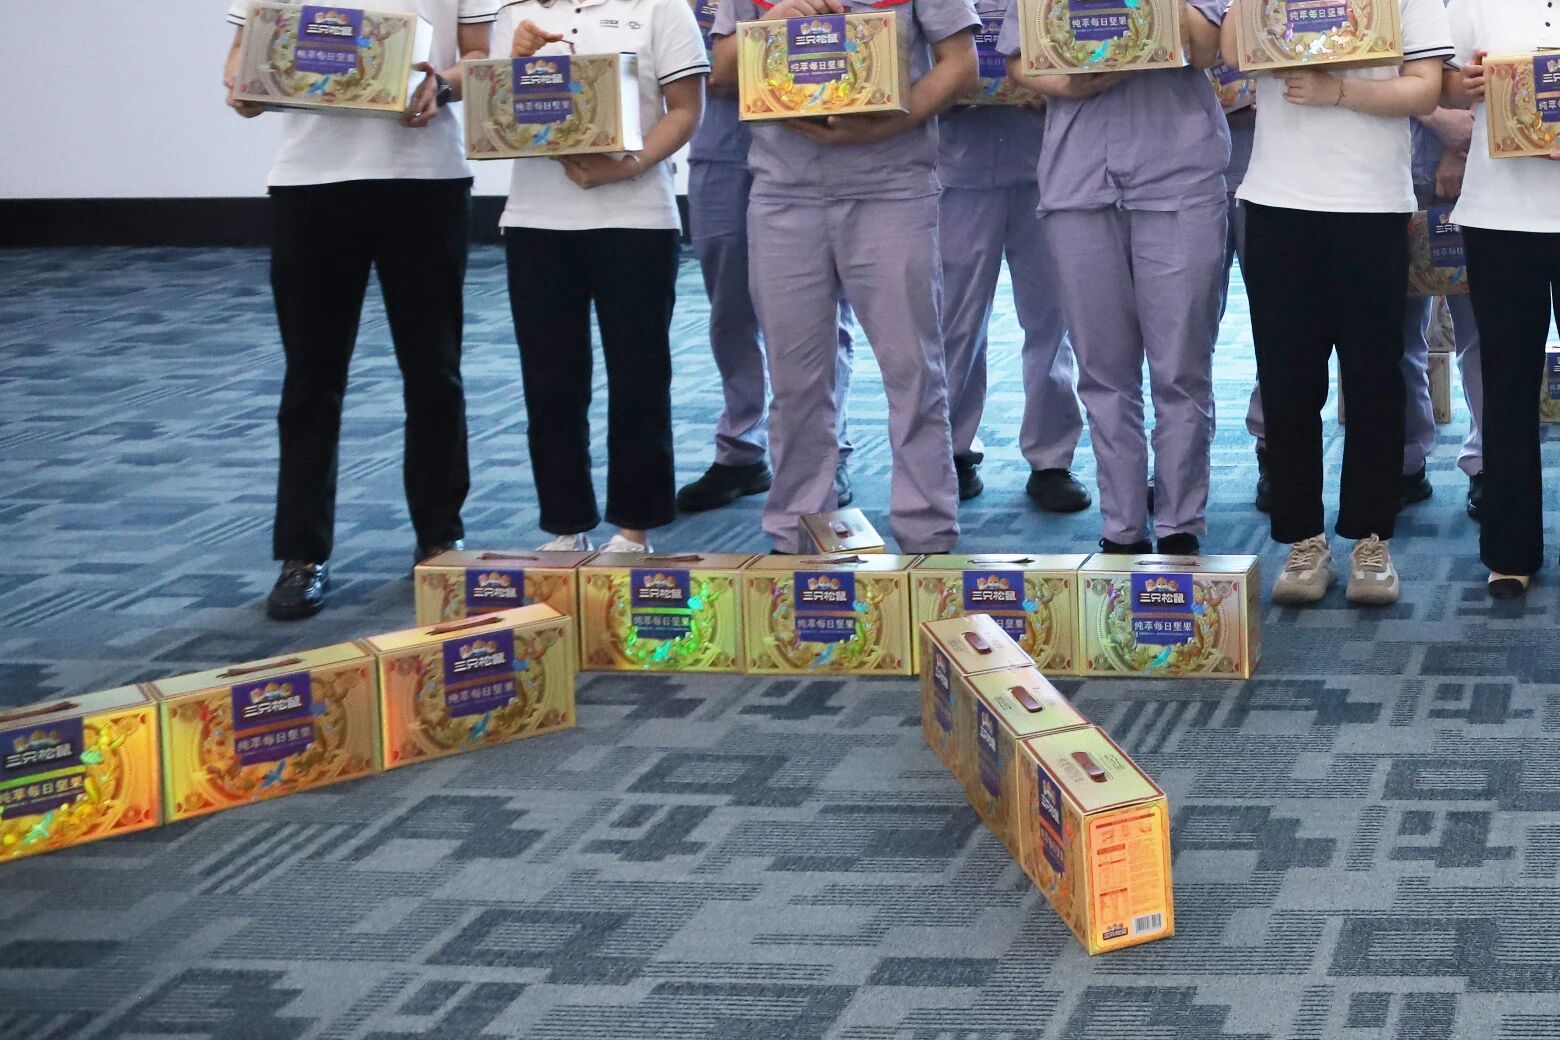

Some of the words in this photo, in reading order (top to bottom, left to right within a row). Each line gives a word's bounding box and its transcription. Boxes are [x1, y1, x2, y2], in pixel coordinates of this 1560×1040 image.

[1289, 8, 1346, 21] 纯萃每日坚果
[1071, 16, 1127, 28] 纯萃每日坚果
[306, 23, 353, 36] 三只松鼠
[795, 33, 839, 46] 三只松鼠
[790, 61, 846, 72] 纯萃每日坚果
[520, 73, 564, 85] 三只松鼠
[473, 587, 517, 598] 三只松鼠
[638, 588, 683, 599] 三只松鼠
[802, 590, 847, 602] 三只松鼠
[971, 590, 1017, 602] 三只松鼠
[1140, 592, 1185, 604] 三只松鼠
[797, 618, 854, 630] 纯萃每日坚果
[1134, 620, 1193, 632] 纯萃每日坚果
[453, 652, 506, 673] 三只松鼠
[244, 695, 303, 718] 三只松鼠
[5, 742, 72, 768] 三只松鼠
